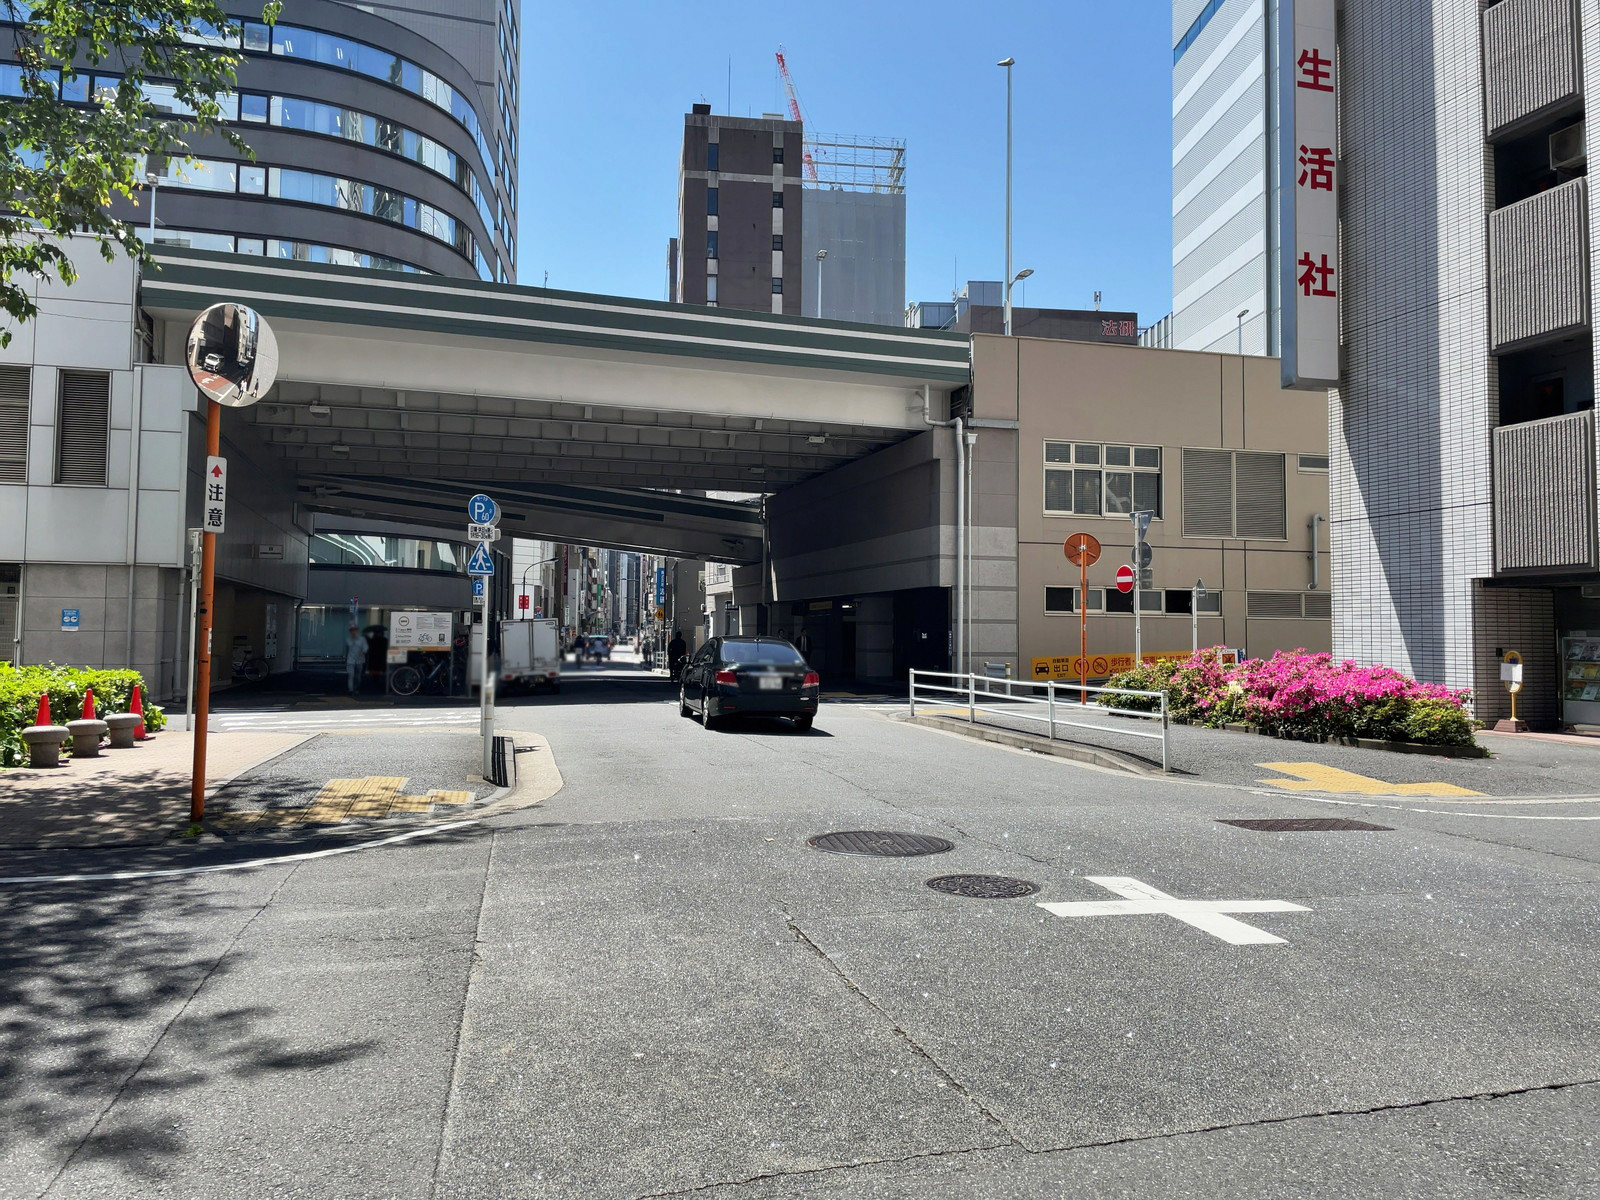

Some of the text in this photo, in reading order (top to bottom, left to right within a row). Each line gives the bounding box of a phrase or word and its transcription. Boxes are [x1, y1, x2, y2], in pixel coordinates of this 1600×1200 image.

[1297, 48, 1337, 298] 生活社
[1102, 320, 1135, 336] 法研
[208, 484, 224, 527] 注意
[474, 502, 485, 521] P
[1053, 664, 1069, 673] 出口
